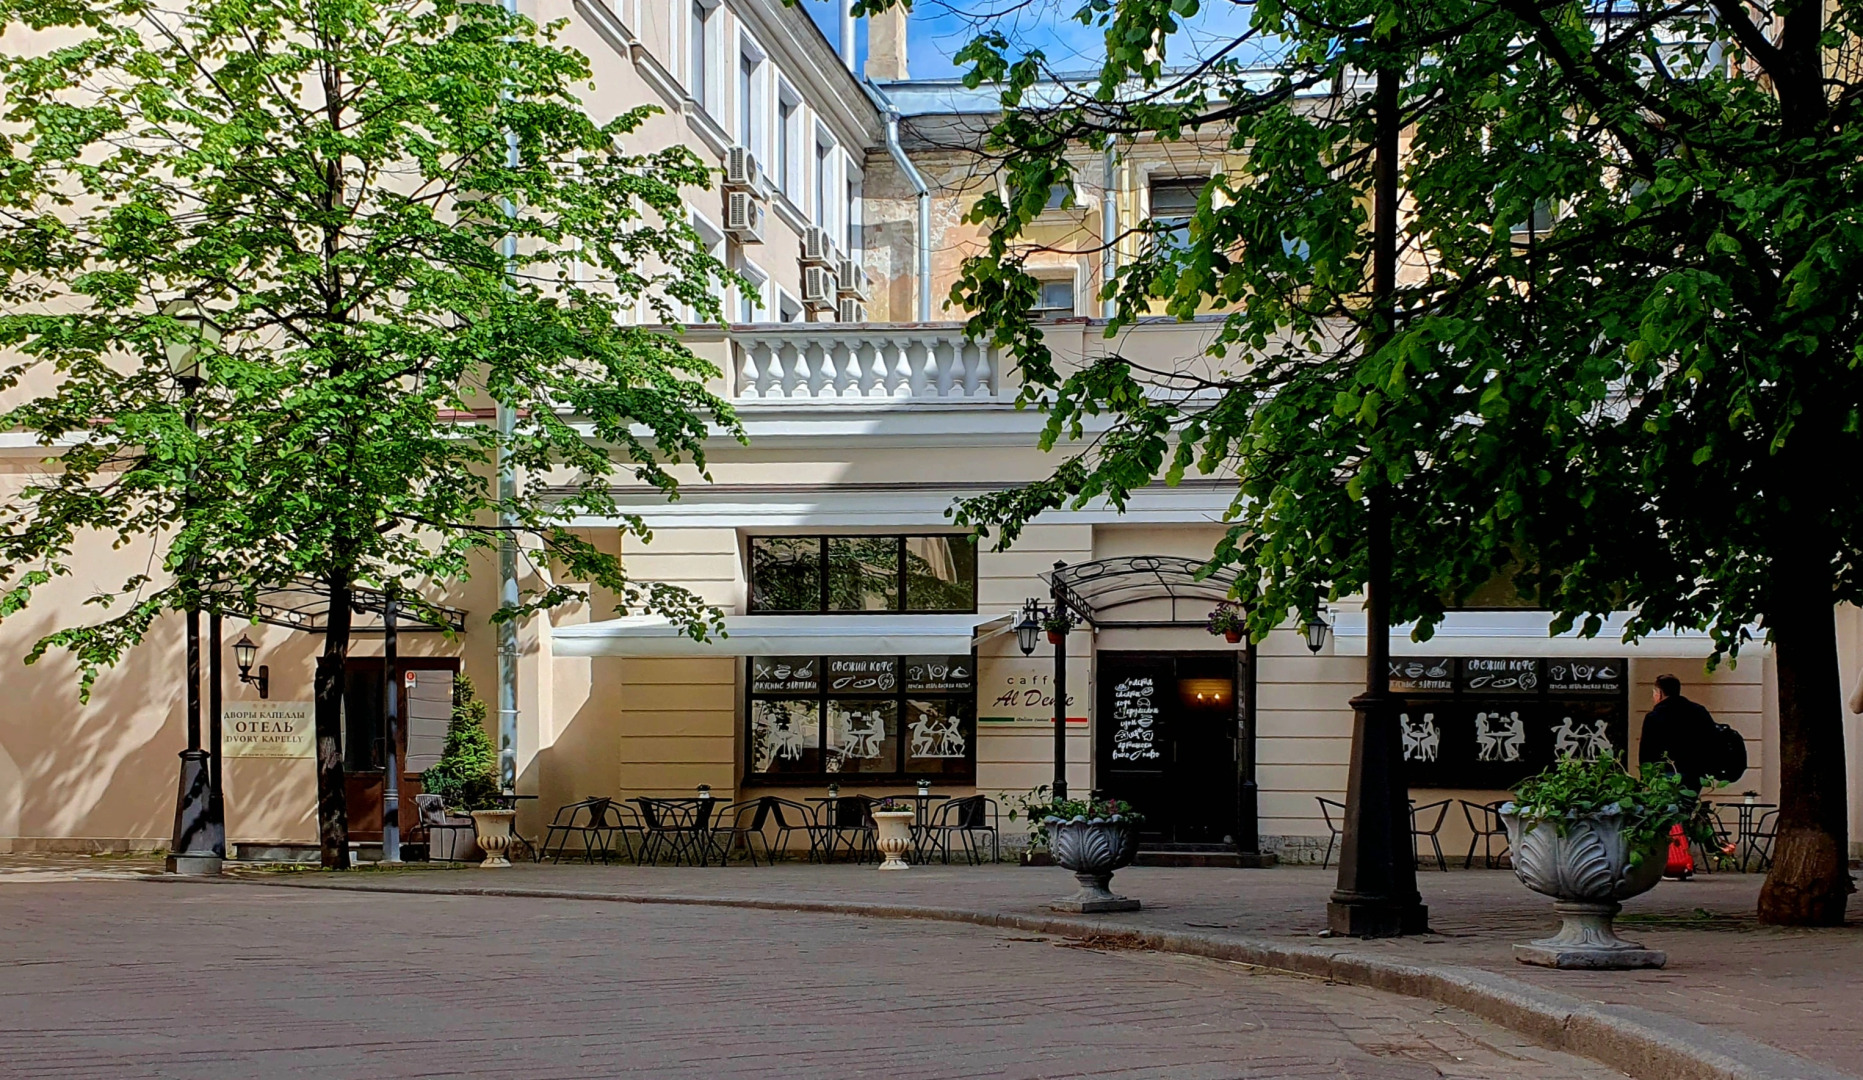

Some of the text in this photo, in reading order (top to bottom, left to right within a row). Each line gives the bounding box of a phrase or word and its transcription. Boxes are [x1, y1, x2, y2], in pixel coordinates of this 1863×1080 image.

[869, 661, 894, 672] КОФЕ
[1509, 659, 1536, 671] КОФЕ
[1006, 675, 1056, 685] caff
[992, 689, 1019, 707] Al
[224, 711, 305, 720] ДВОРЫ КАПЕЛЛЫ
[235, 721, 294, 733] ОТЕЛЬ
[226, 735, 304, 743] DVORY KAPELLY
